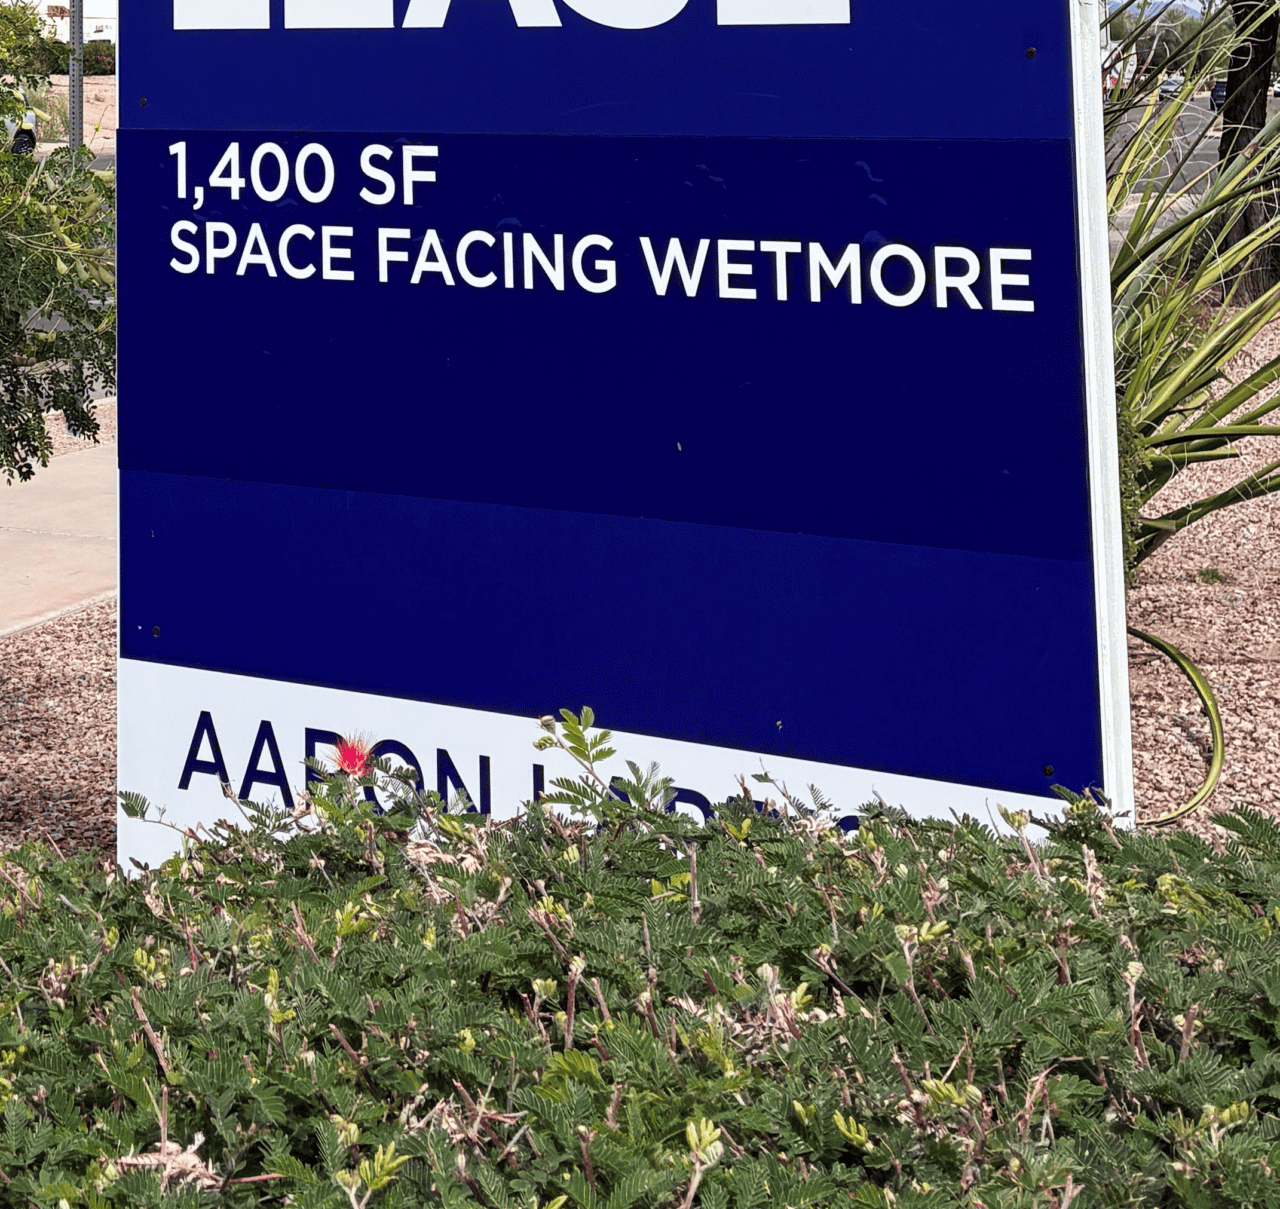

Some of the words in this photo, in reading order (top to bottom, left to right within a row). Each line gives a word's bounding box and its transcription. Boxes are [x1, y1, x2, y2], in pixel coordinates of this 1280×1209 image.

[168, 141, 335, 211] 1,400
[359, 143, 439, 206] SF
[169, 219, 355, 281] SPACE
[378, 227, 617, 294] FACING
[639, 236, 1035, 312] WETMORE
